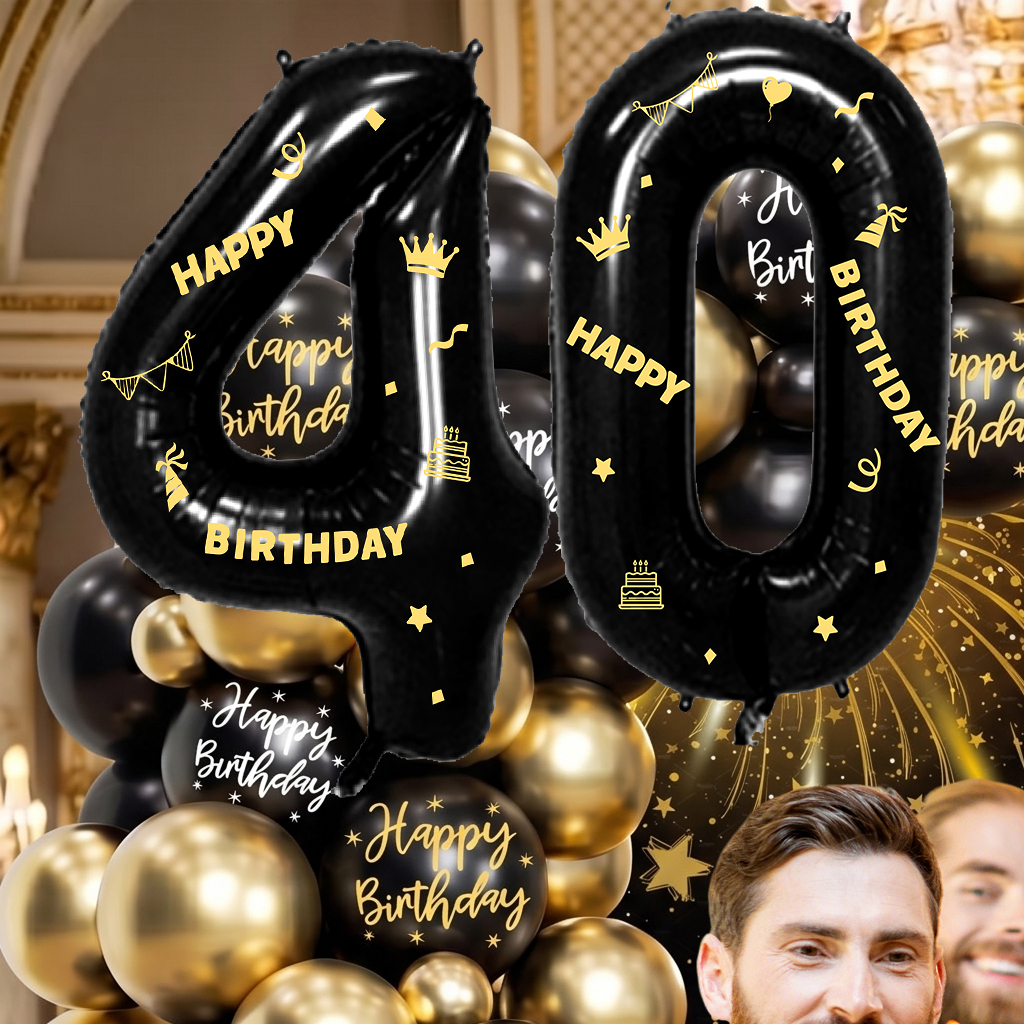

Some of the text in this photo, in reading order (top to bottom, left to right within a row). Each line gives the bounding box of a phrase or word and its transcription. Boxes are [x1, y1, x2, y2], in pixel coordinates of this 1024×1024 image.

[170, 208, 294, 296] HAPPY
[747, 238, 815, 288] Birt
[566, 316, 691, 405] HAPPY
[829, 258, 941, 453] BIRTHDAY
[221, 384, 350, 445] Birthda
[204, 522, 408, 565] BIRTHDAY
[212, 682, 337, 761] Happy
[195, 738, 332, 813] Birthday
[364, 801, 517, 872] Happy
[355, 870, 531, 930] Birthday
